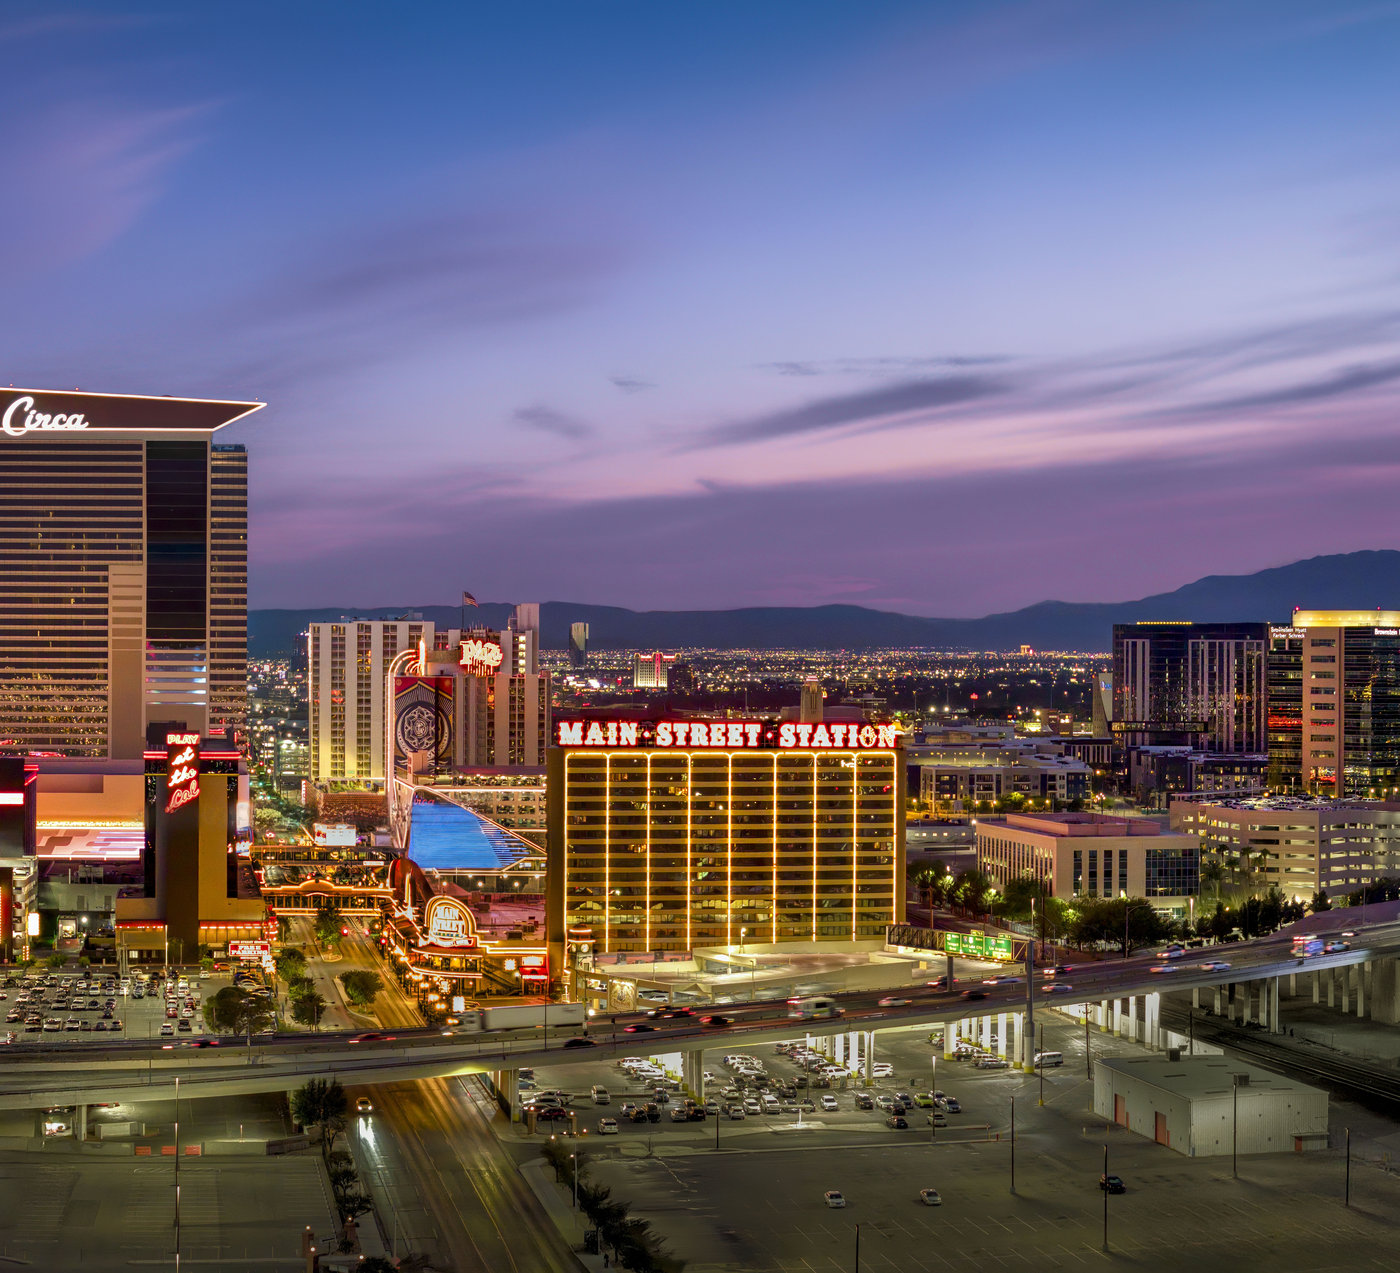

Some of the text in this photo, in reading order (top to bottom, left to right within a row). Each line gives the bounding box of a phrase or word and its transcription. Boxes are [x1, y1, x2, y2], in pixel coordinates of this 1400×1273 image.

[2, 396, 89, 436] Circa
[168, 734, 199, 745] PLAY
[559, 722, 897, 748] MAIN STREET STATION
[171, 746, 195, 766] at
[168, 766, 198, 787] the
[165, 779, 200, 813] Cal
[435, 906, 460, 920] MAIN
[433, 919, 465, 935] STREET
